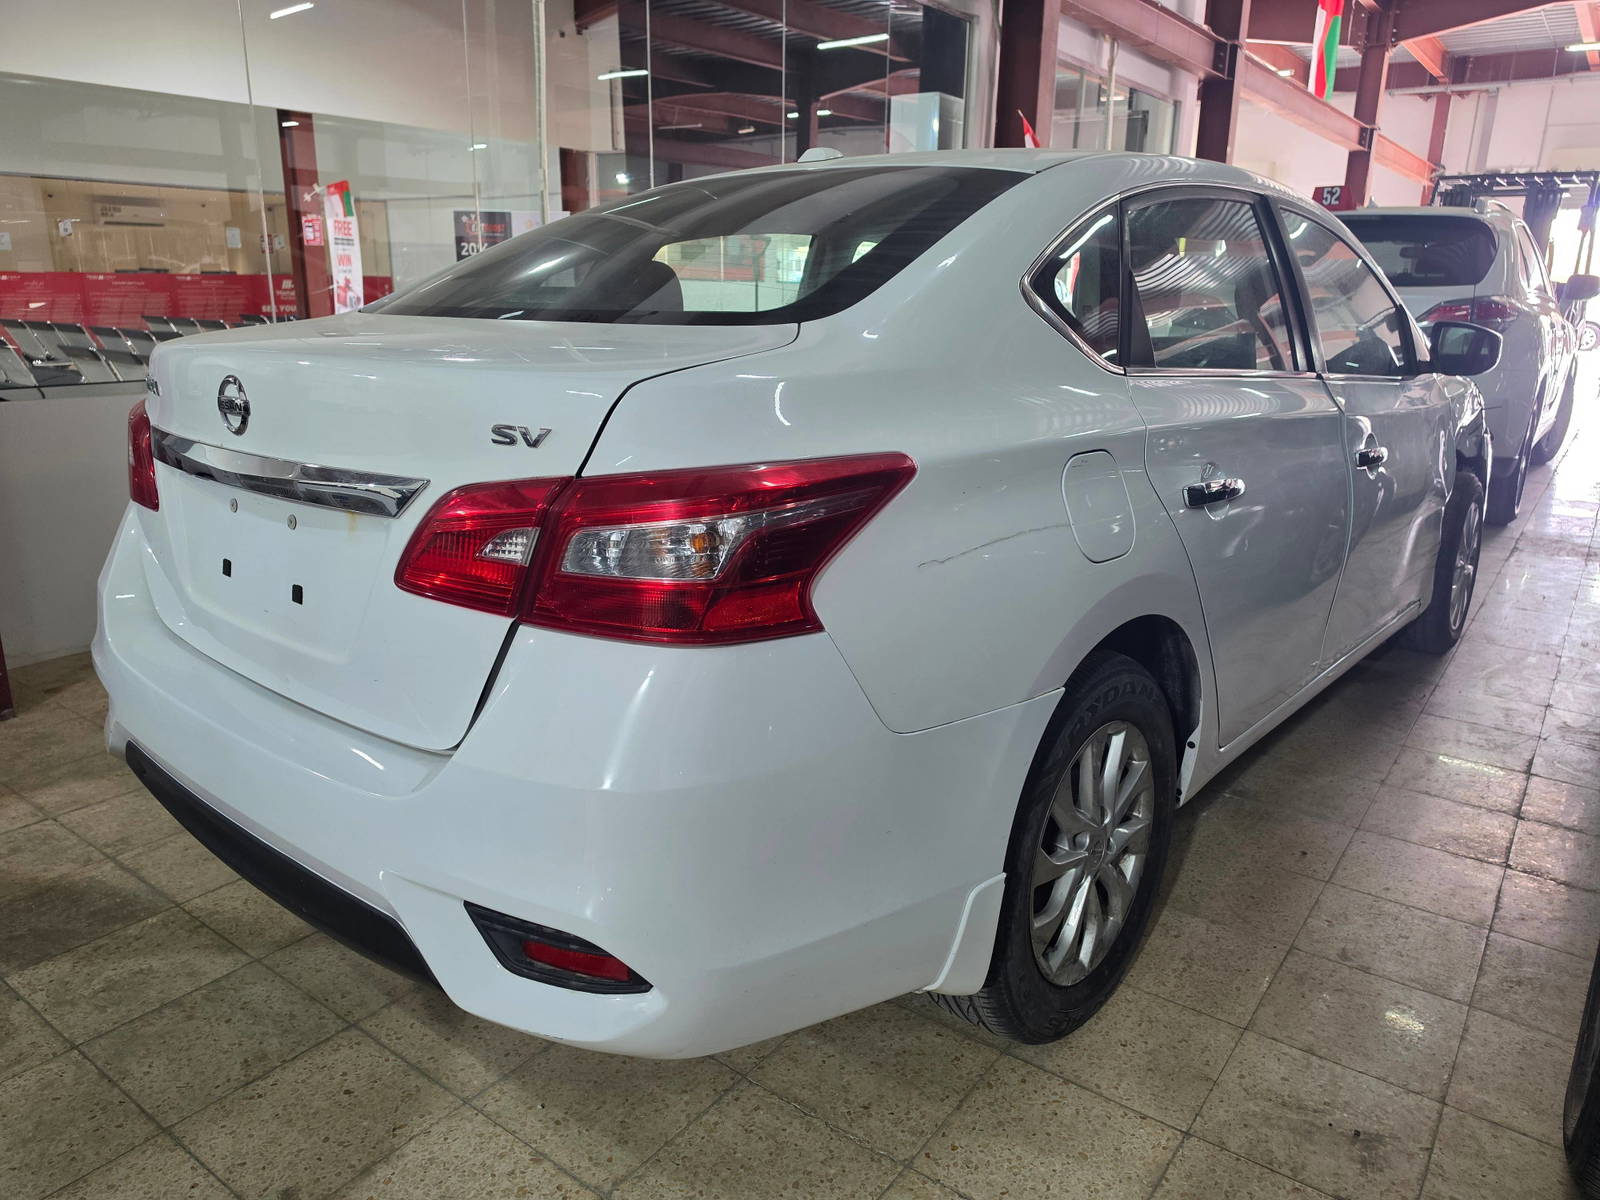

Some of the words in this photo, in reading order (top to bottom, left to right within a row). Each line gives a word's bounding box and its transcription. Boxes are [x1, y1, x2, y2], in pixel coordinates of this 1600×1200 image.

[1322, 186, 1341, 205] 52
[334, 219, 353, 237] FREE
[491, 424, 552, 449] SV
